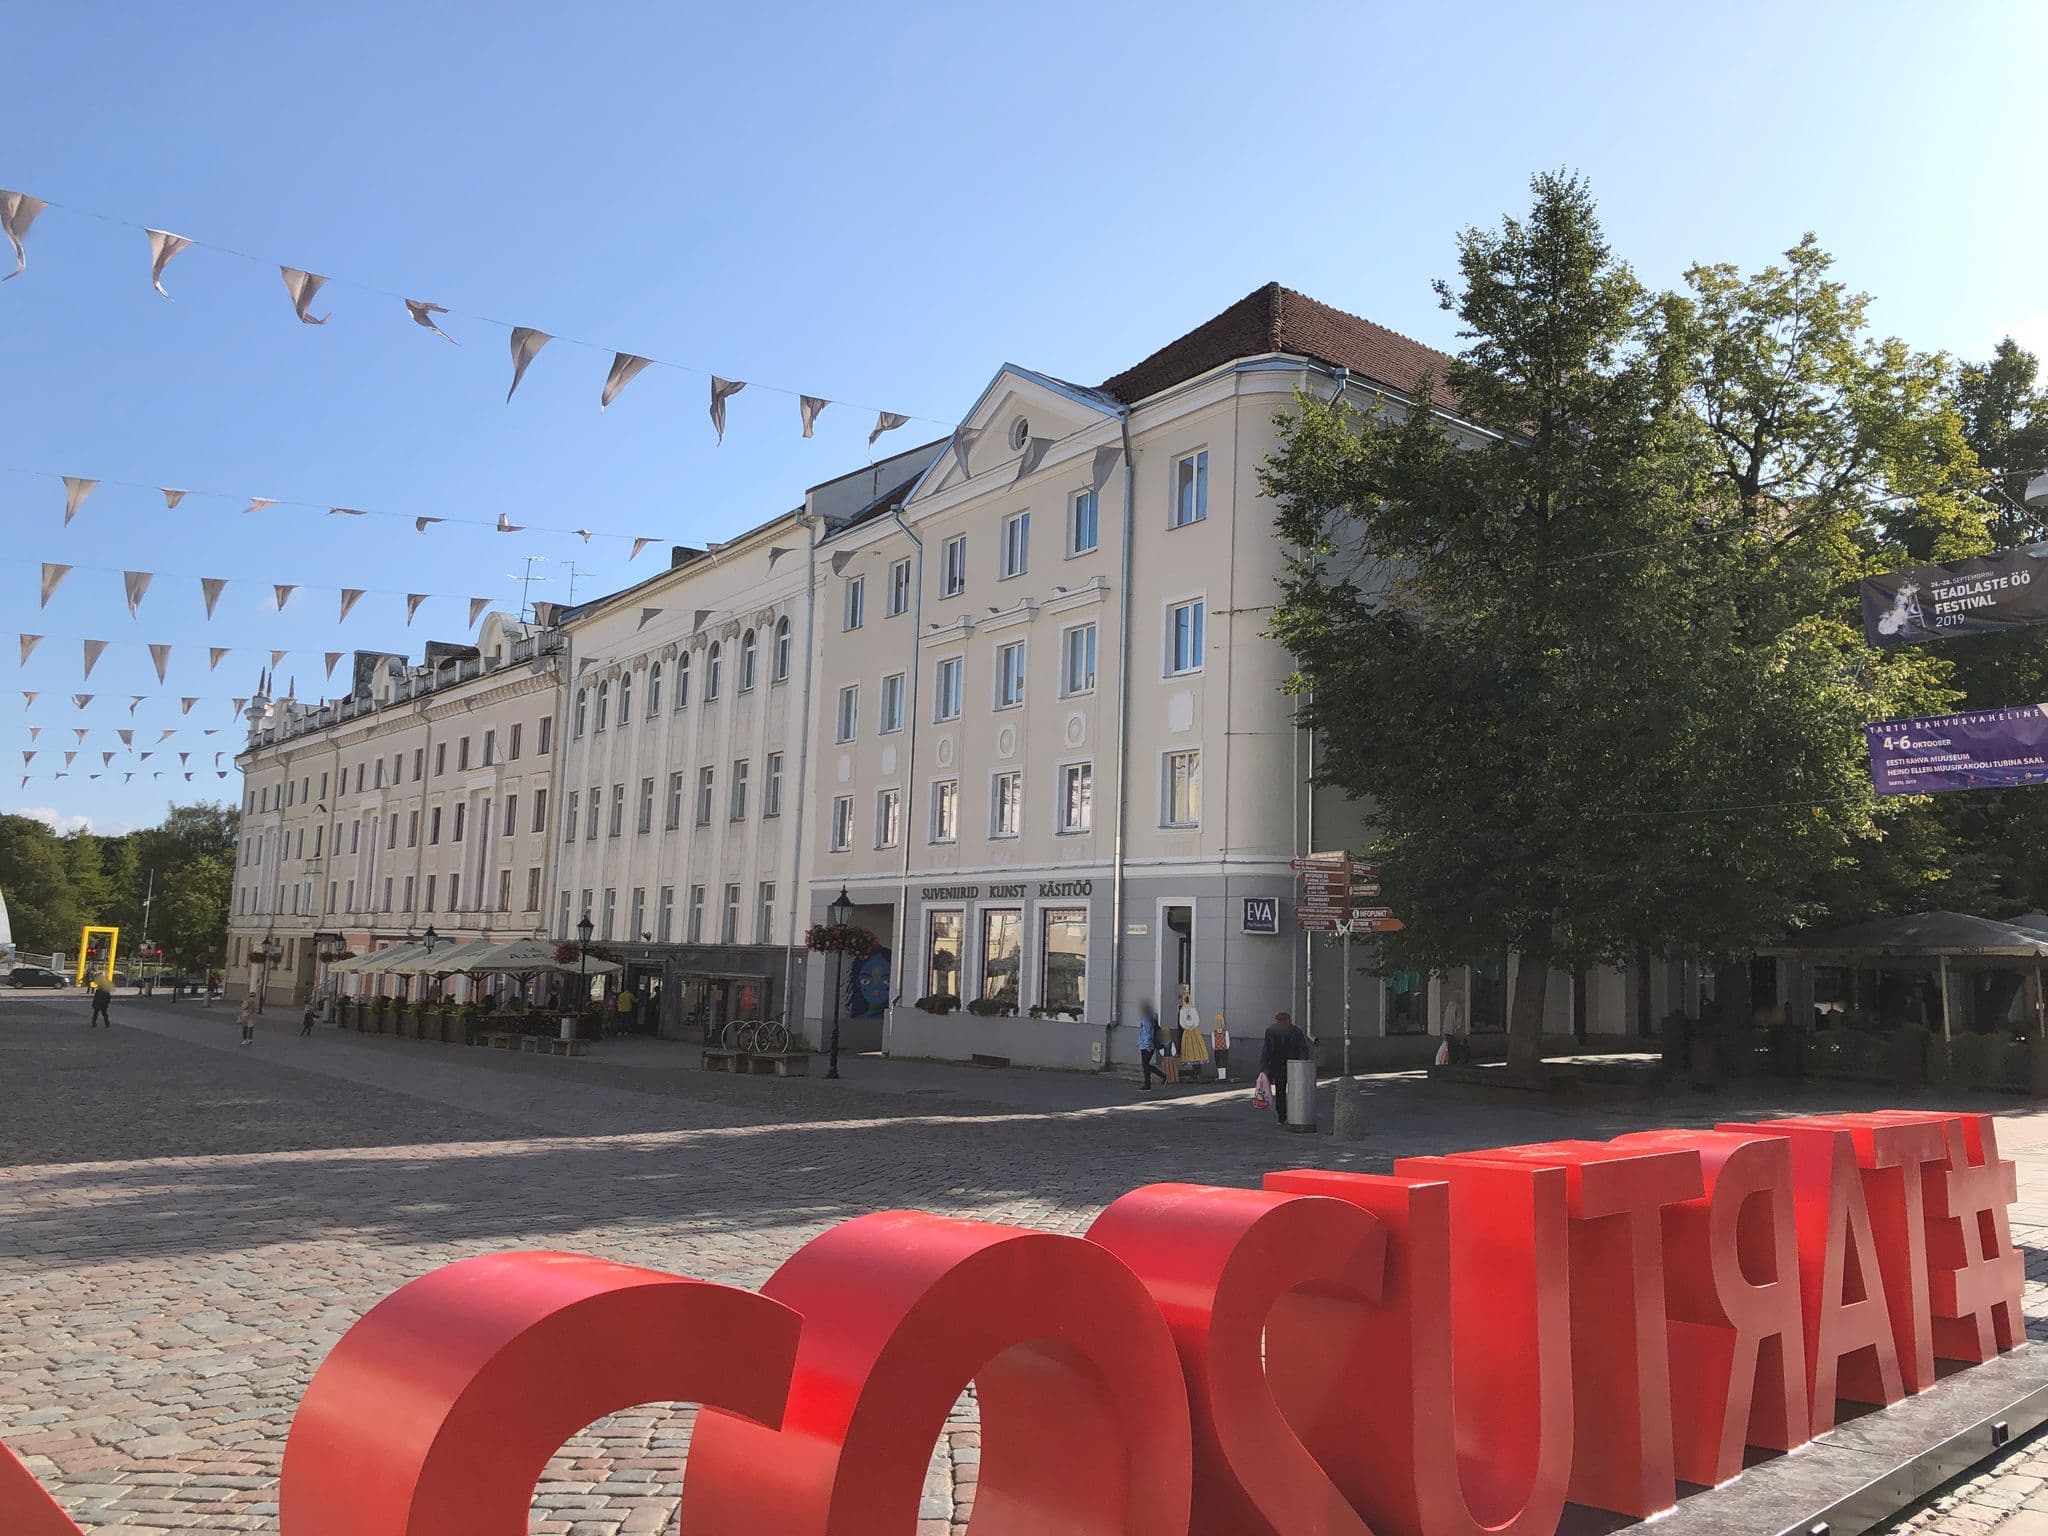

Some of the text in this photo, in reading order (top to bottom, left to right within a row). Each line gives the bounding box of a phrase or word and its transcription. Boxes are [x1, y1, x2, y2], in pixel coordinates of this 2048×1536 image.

[1932, 570, 2031, 601] TEADLASTE ÖÖ
[1935, 594, 1996, 615] FESTIVAL
[1935, 613, 1965, 627] 2019
[1870, 708, 2040, 734] TARTU RAHVUSVAHELINE
[1883, 735, 1952, 750] 4-6 OKTOOBER
[1886, 753, 1970, 767] EESTI RAHVA MUUSEUM
[1887, 756, 2045, 776] HEINO ELLERI MUUSIKAKOOLI TUBINA SAAL
[921, 880, 1093, 900] SUVENIIRID KUNST KÄSITÖÖ
[1247, 901, 1272, 921] EVA
[1359, 909, 1388, 918] INFOPUNKT
